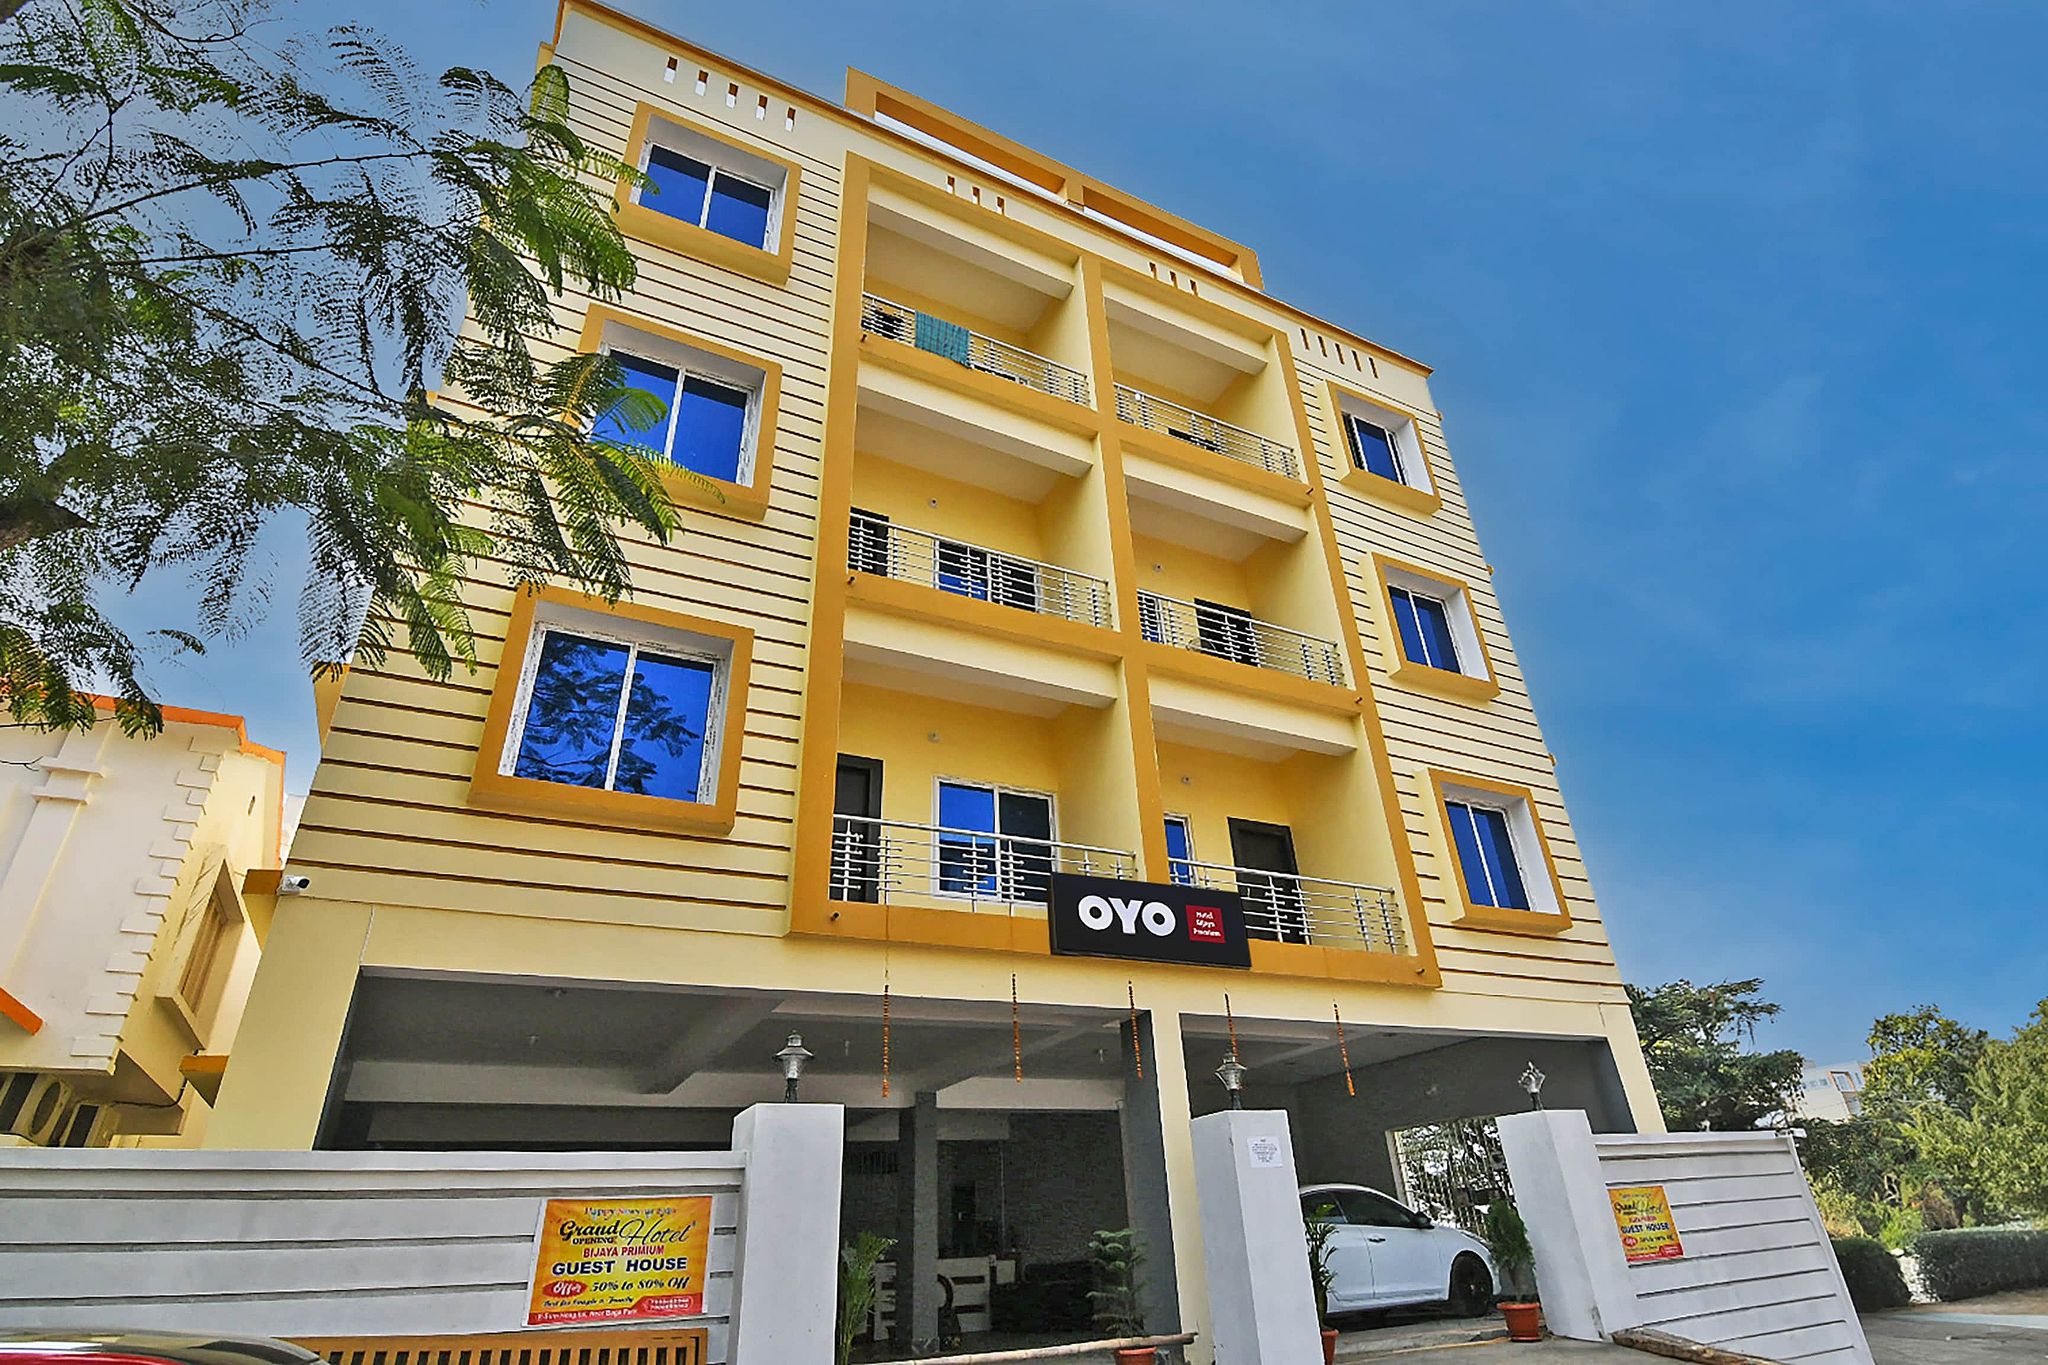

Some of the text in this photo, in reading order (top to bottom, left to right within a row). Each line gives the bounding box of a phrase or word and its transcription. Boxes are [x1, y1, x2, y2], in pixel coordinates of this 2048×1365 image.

[1077, 894, 1177, 937] OYO
[559, 1218, 692, 1246] Grand Hotel
[583, 1247, 618, 1258] BIJAYA
[552, 1257, 687, 1275] GUEST HOUSE
[591, 1281, 619, 1292] 50%
[621, 1279, 633, 1290] to
[667, 1276, 690, 1289] Off
